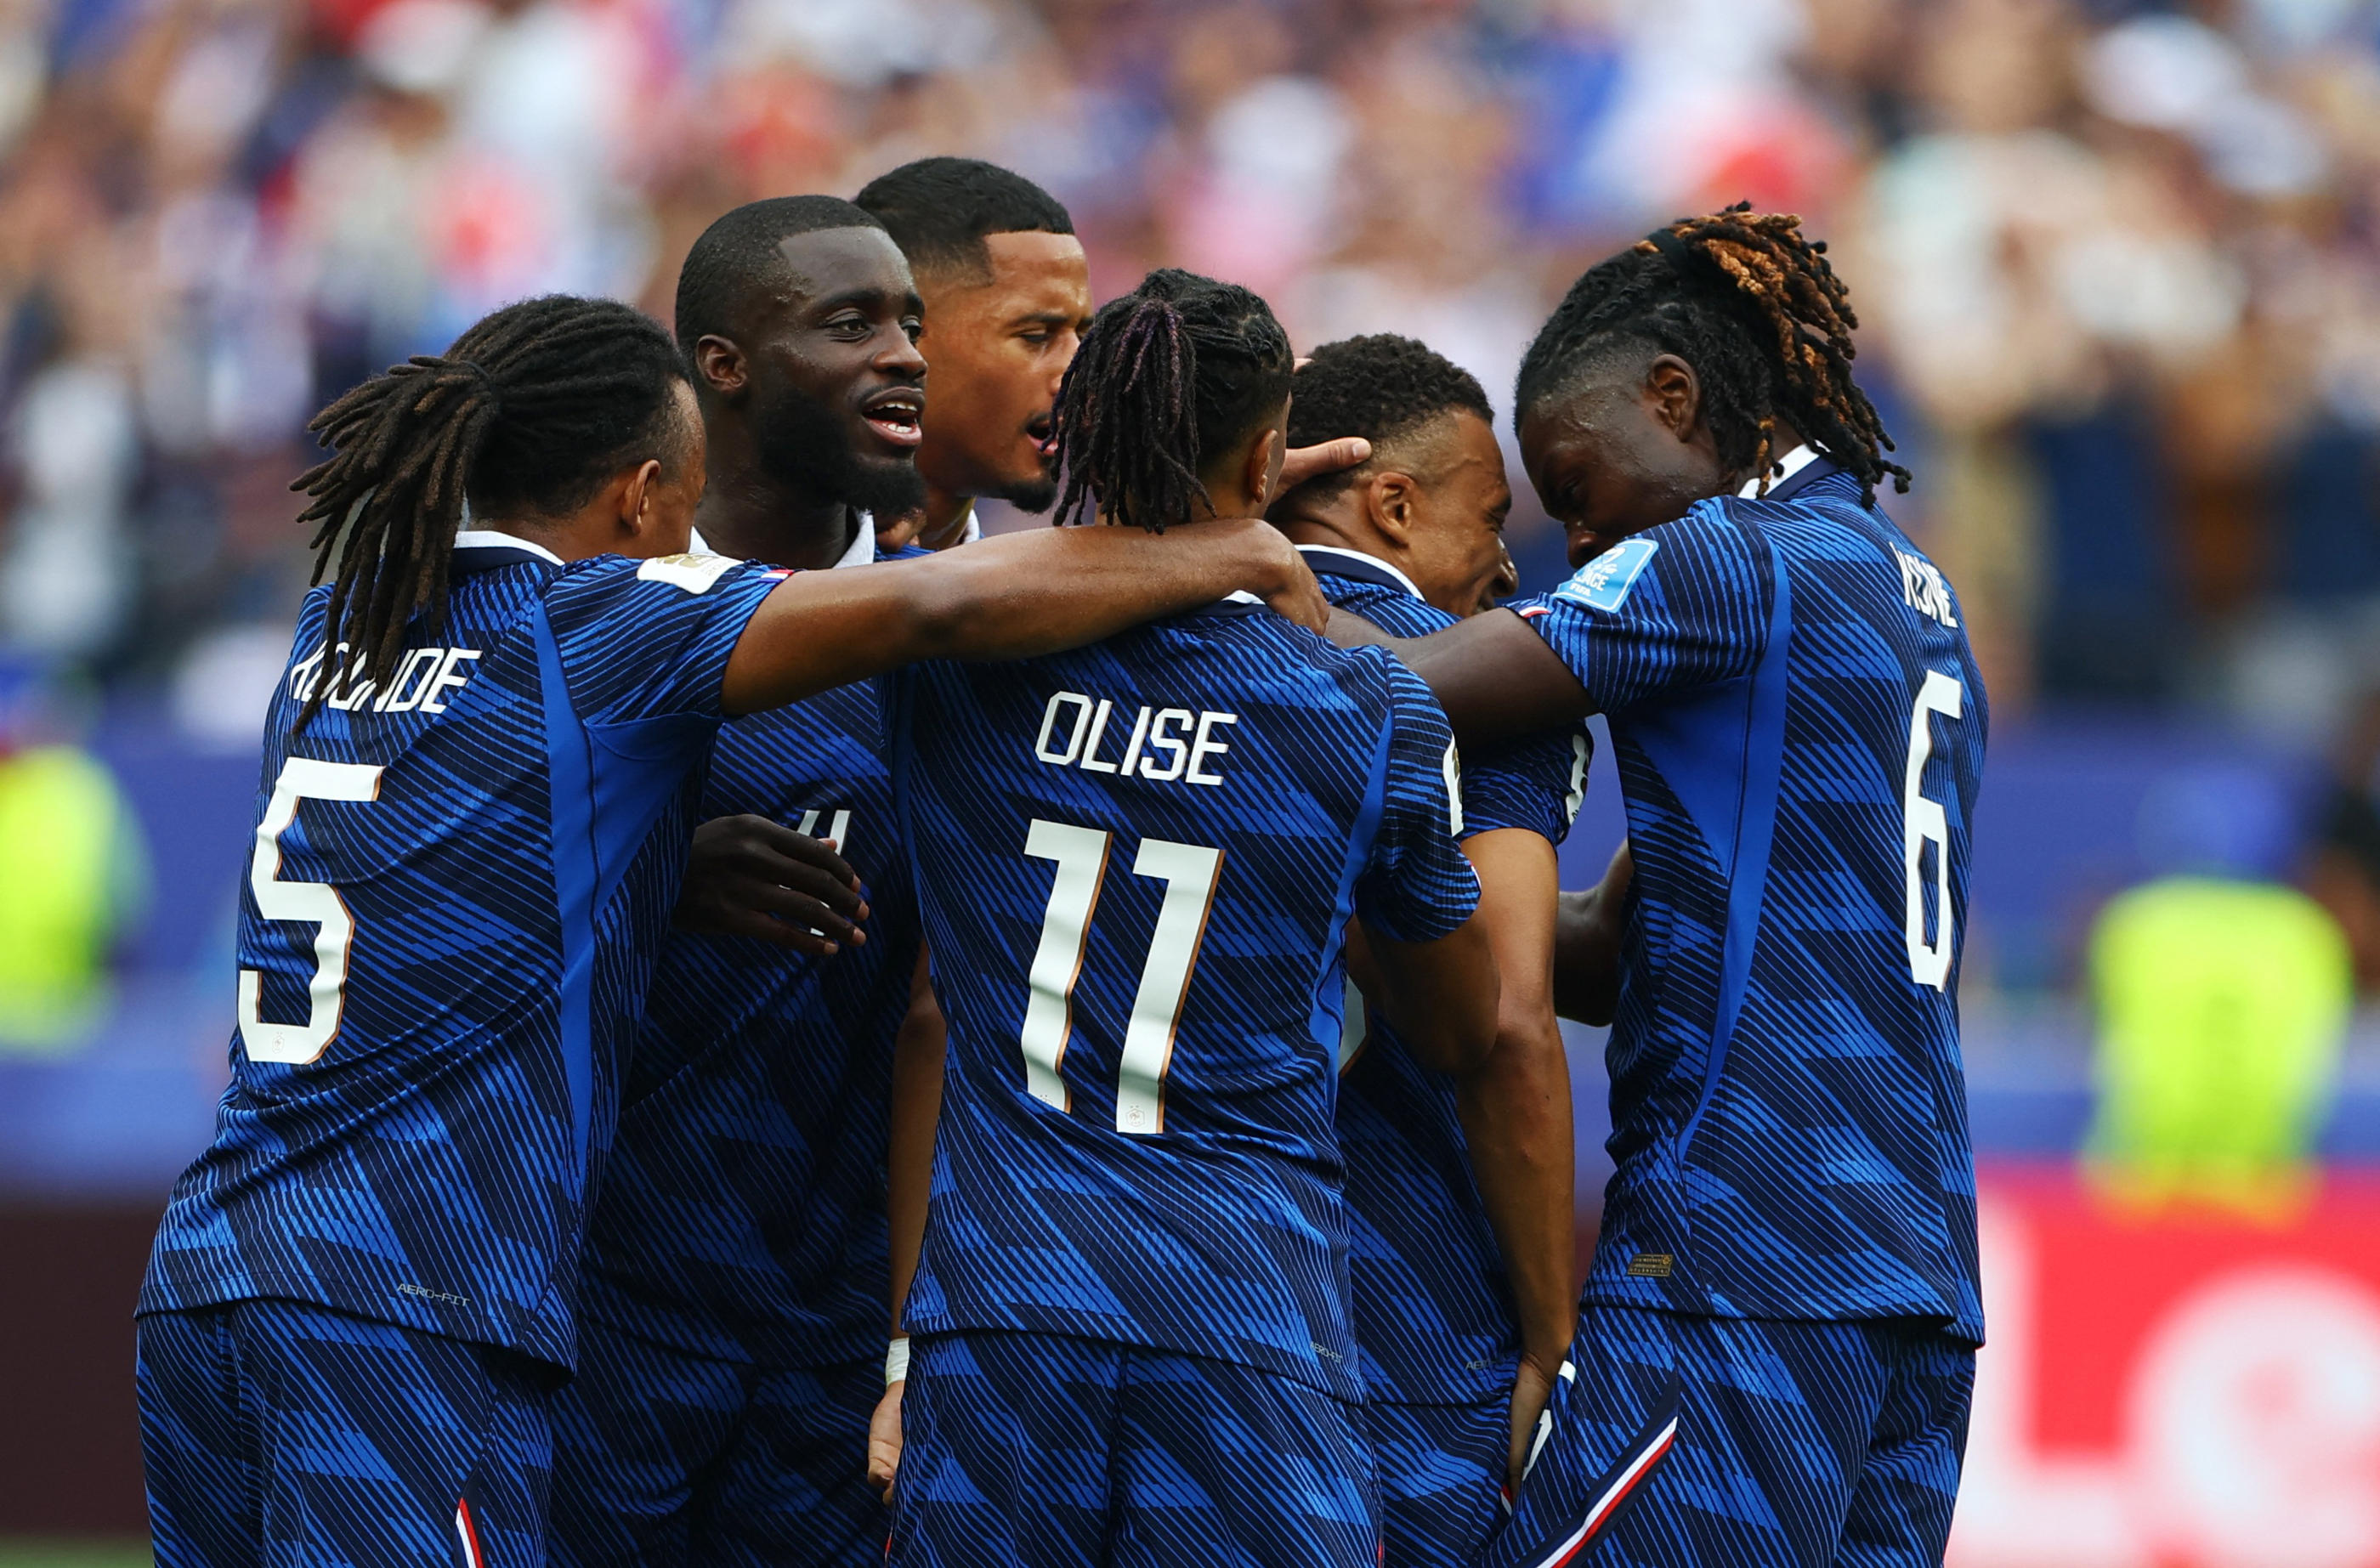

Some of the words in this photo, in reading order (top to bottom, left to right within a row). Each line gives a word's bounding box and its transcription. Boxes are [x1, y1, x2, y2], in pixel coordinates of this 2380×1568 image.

[1569, 582, 1592, 597] FIFA
[1889, 541, 1958, 628] KONE
[1035, 691, 1238, 785] OLISE
[1904, 670, 1960, 993] 6
[238, 757, 386, 1065] 5
[1022, 818, 1226, 1134] 11
[396, 1282, 471, 1307] AERO-FIT
